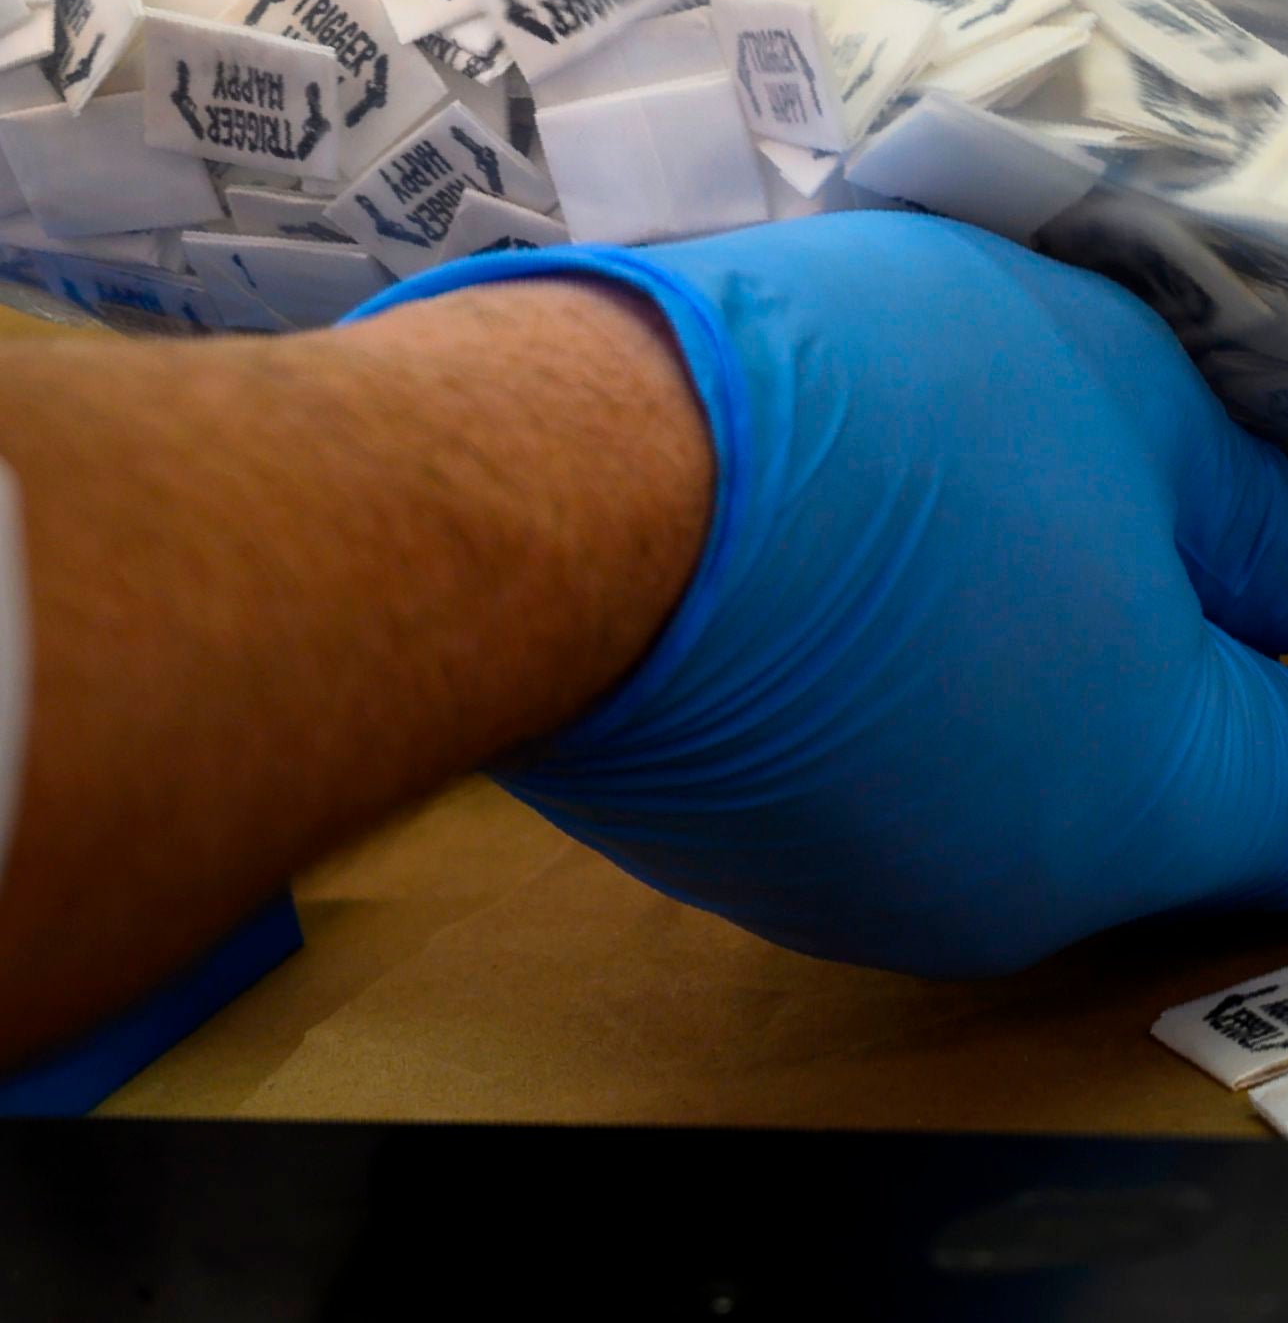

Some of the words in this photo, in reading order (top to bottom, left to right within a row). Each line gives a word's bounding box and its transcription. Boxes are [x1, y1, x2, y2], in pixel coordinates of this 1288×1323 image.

[211, 61, 285, 111] HAPPY
[205, 105, 296, 159] TRIGGER
[379, 140, 454, 204] HAPPY
